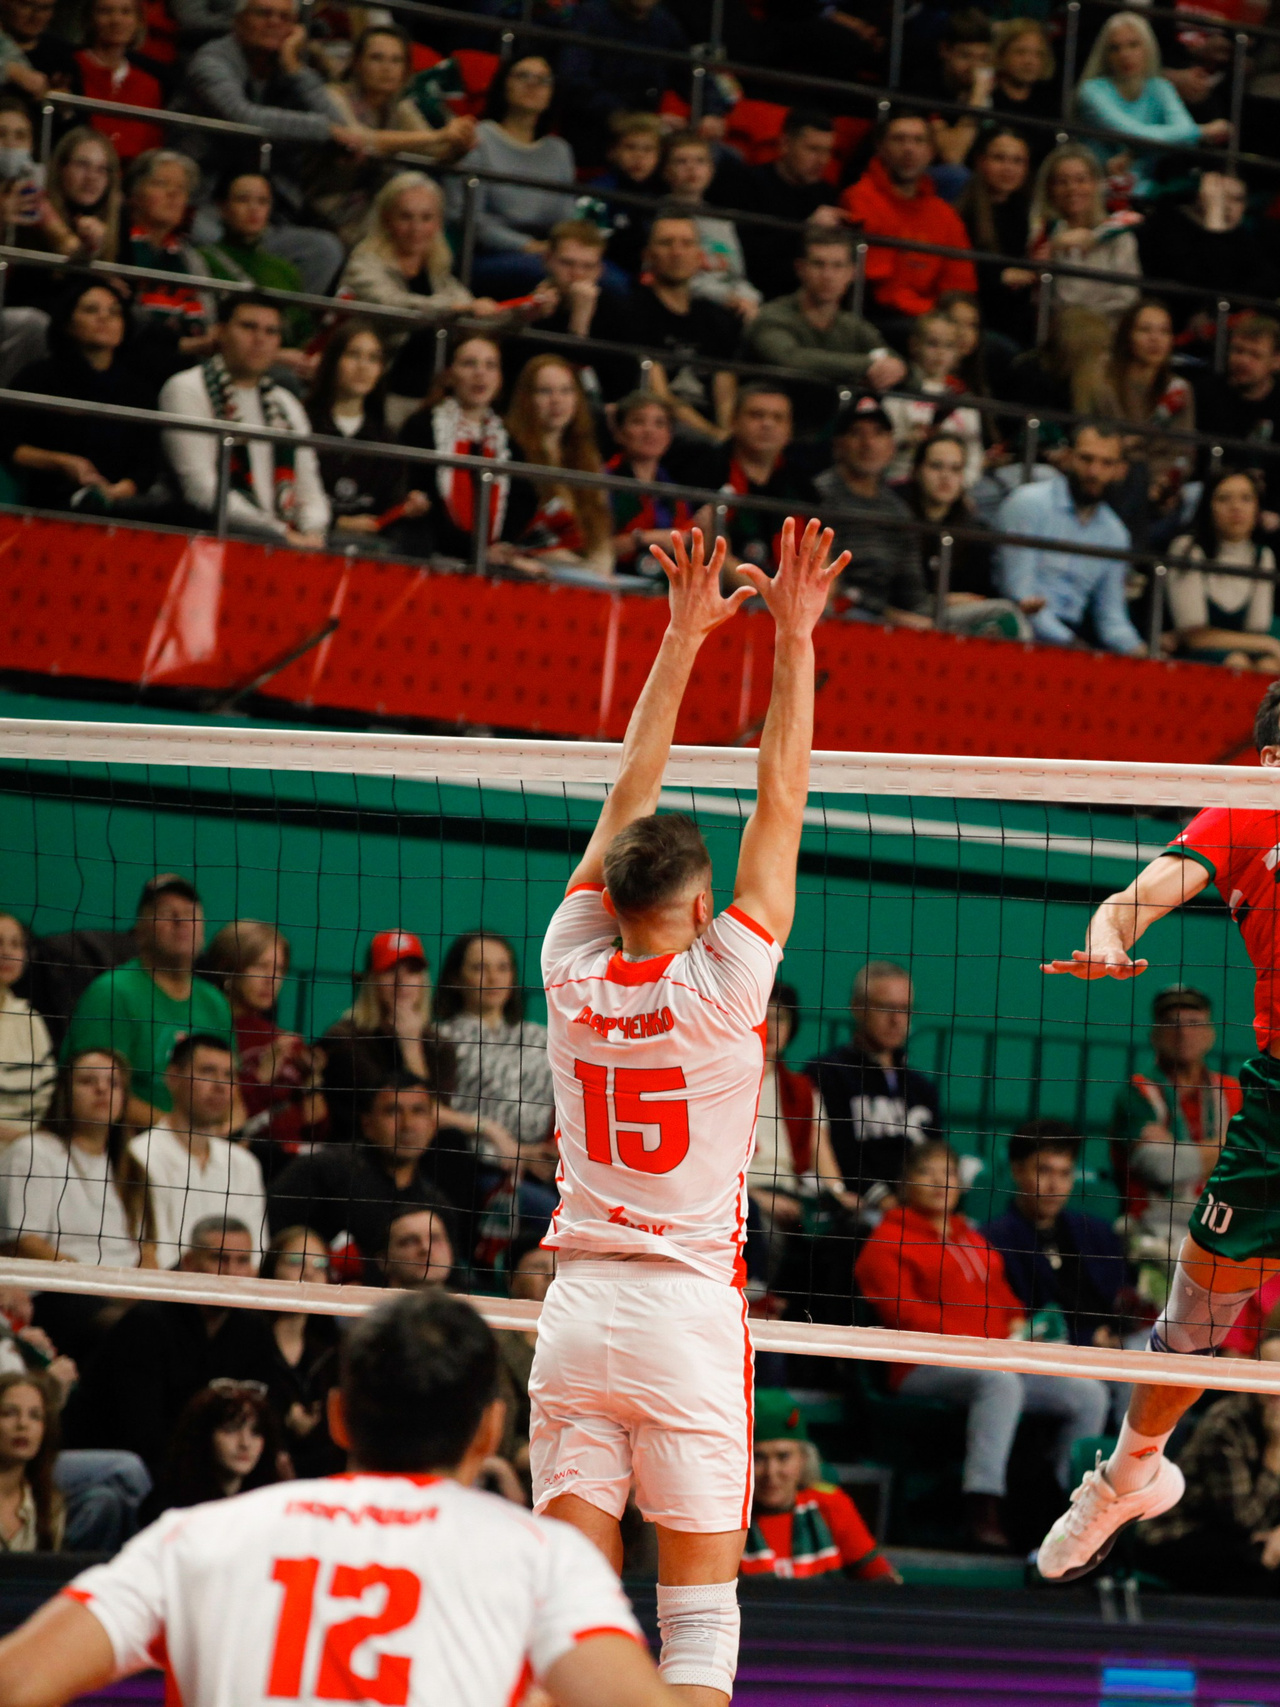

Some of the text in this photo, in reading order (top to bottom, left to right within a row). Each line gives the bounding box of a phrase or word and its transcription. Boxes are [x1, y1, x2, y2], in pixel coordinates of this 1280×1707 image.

[574, 1057, 690, 1175] 15
[1200, 1192, 1234, 1234] 10
[265, 1556, 422, 1706] 12
